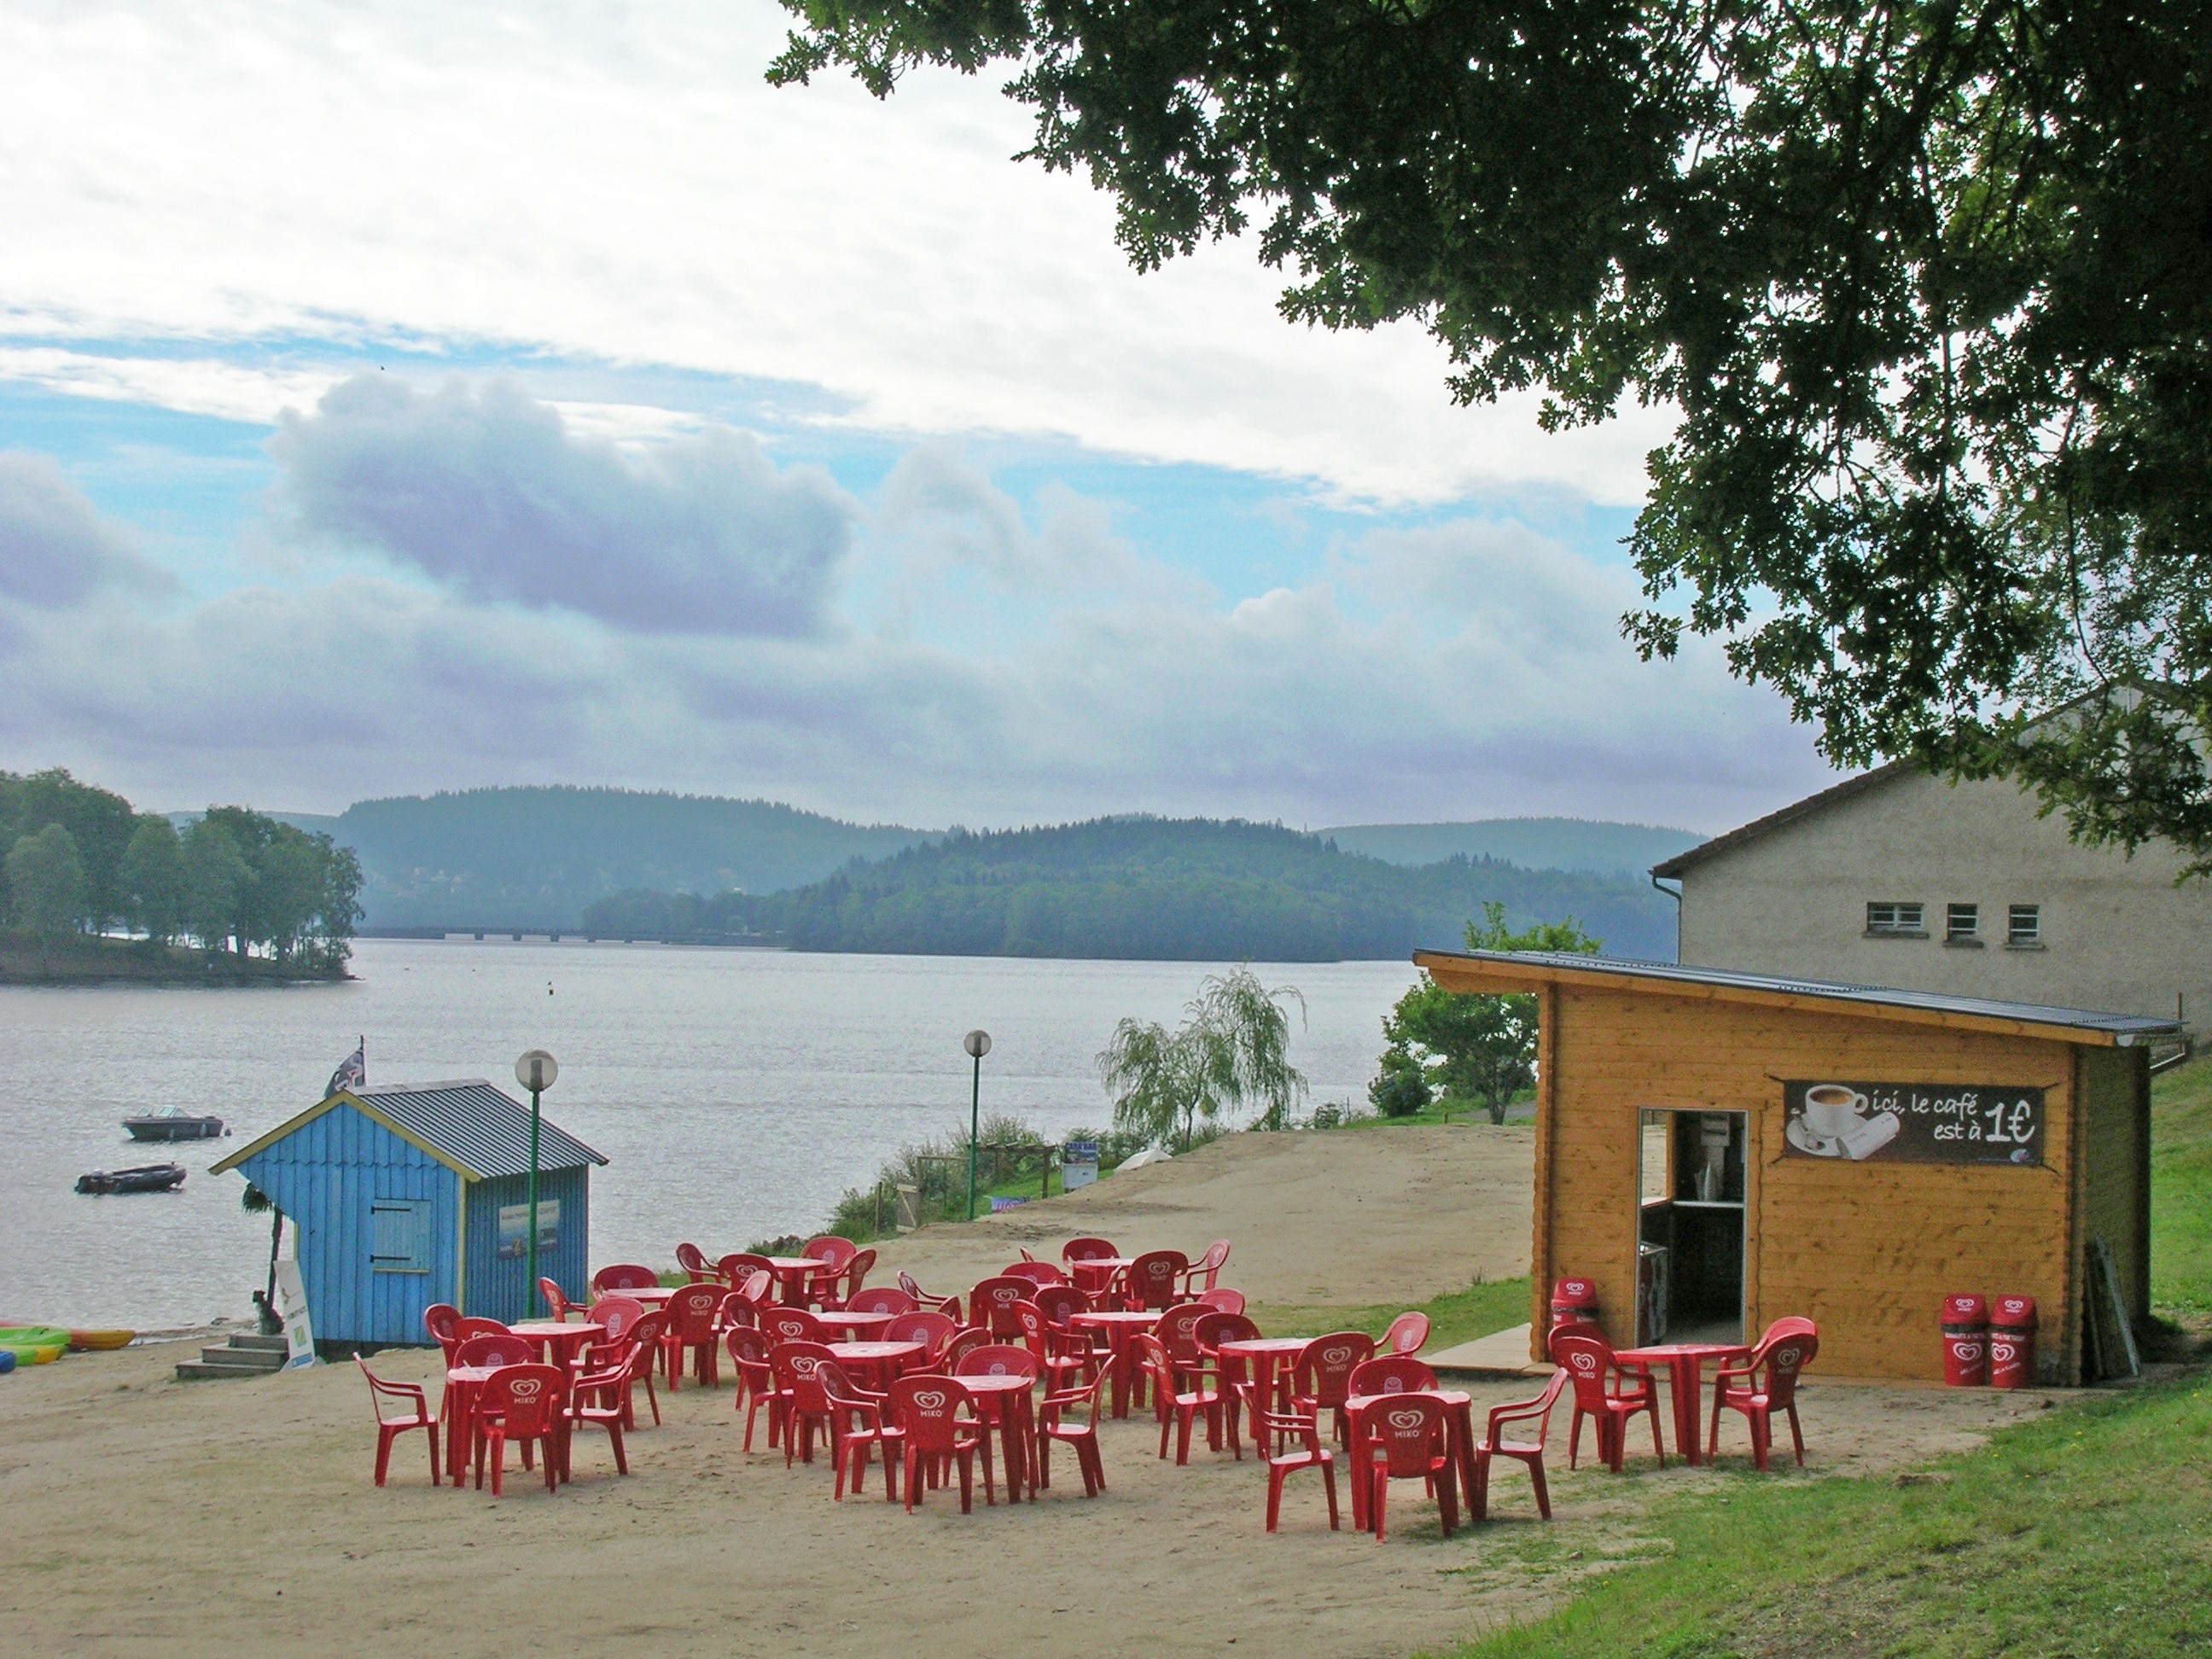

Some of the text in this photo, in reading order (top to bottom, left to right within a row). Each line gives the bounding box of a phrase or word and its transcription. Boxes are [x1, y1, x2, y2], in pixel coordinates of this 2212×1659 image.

[1872, 1090, 1978, 1121] ici, le café
[1934, 1100, 2036, 1143] est à 1€
